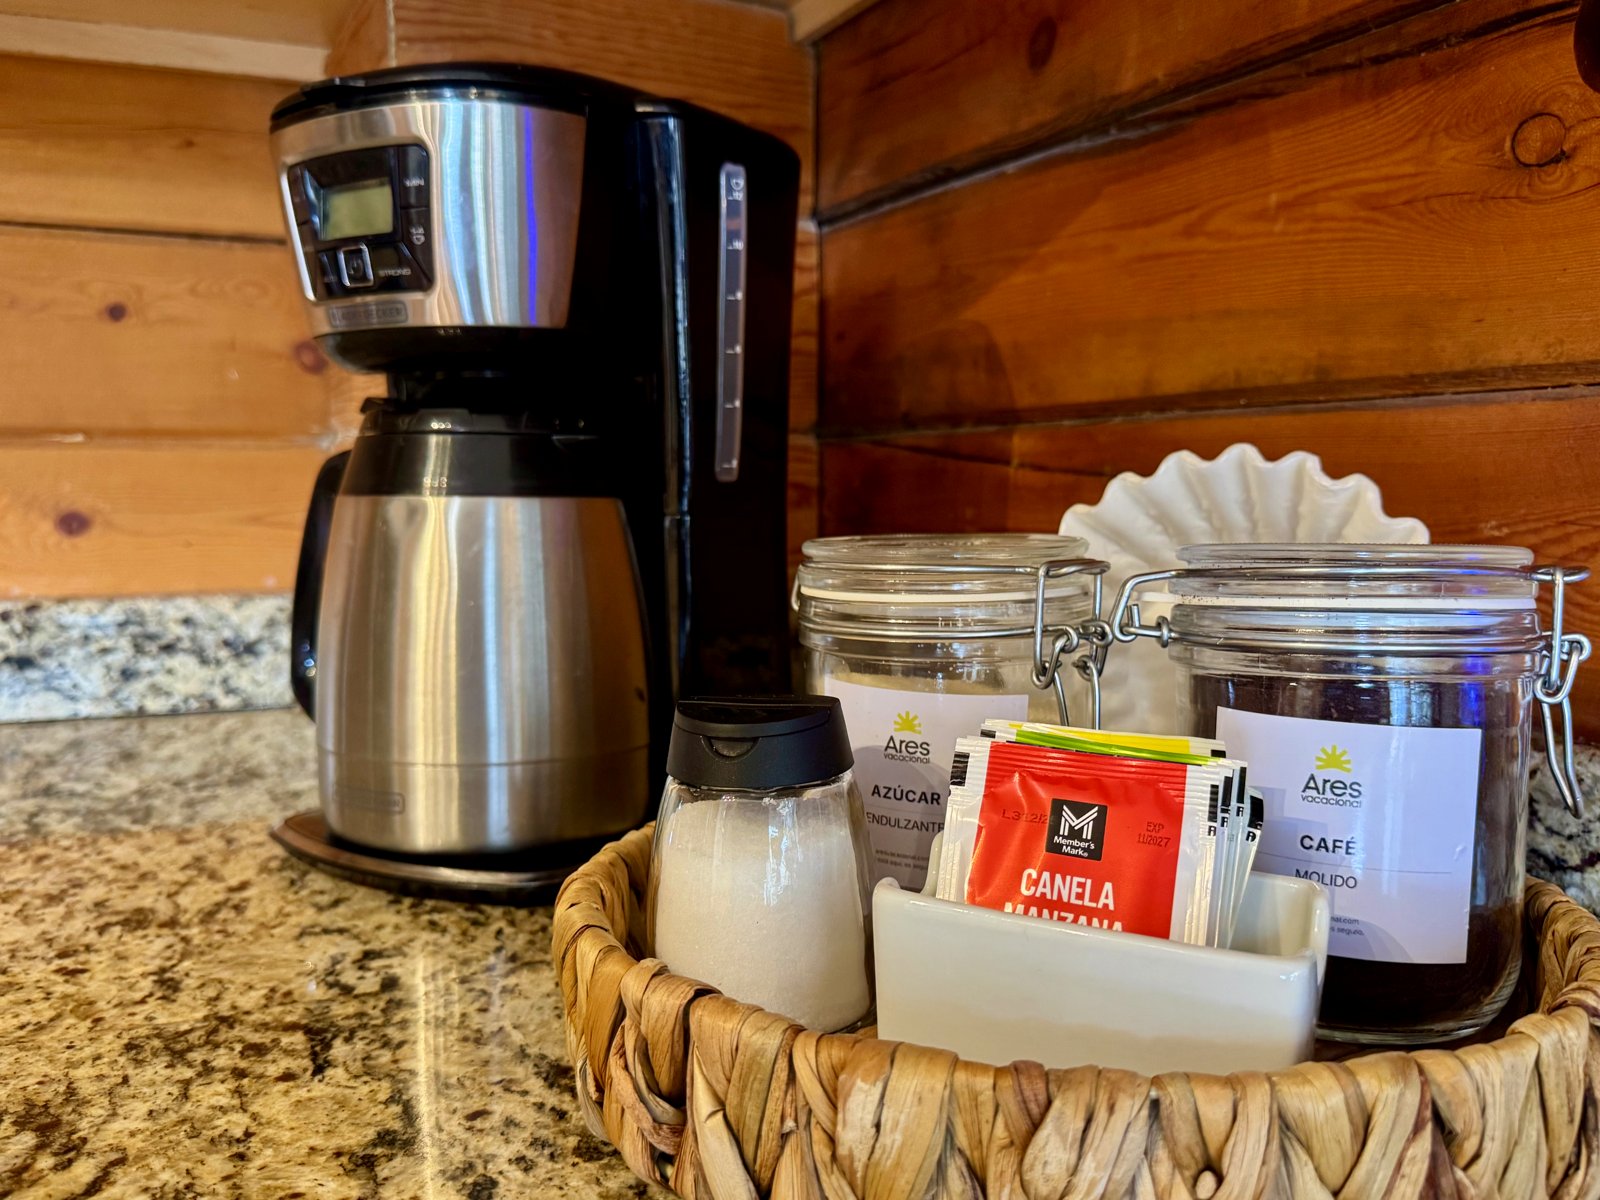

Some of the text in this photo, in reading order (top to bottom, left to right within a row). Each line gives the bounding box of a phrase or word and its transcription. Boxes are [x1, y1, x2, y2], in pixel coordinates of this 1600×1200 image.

[884, 735, 930, 756] Ares
[883, 752, 931, 764] vacacional
[871, 784, 941, 806] AZÚCAR
[1301, 773, 1362, 798] Ares
[1301, 794, 1362, 808] vacacional
[1146, 821, 1165, 833] EXP
[1053, 835, 1095, 850] Member's
[1299, 834, 1357, 856] CAFÉ
[1020, 868, 1115, 911] CANELA
